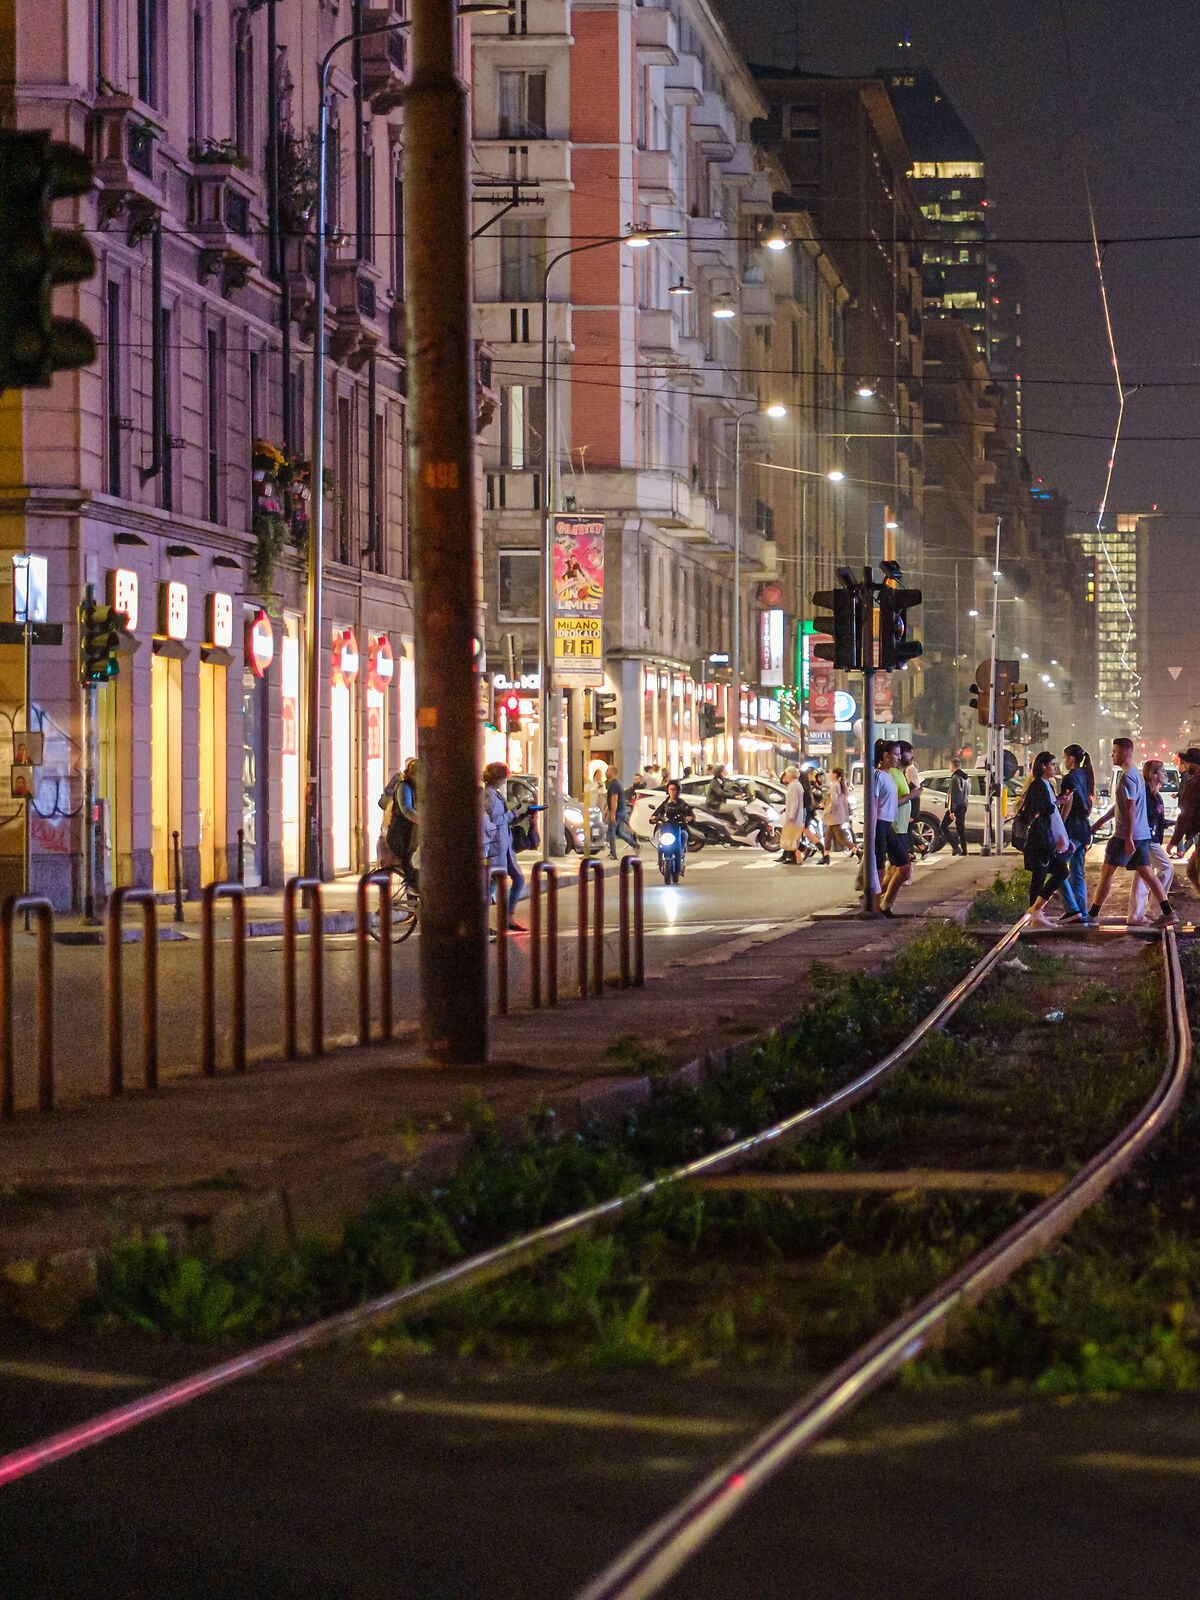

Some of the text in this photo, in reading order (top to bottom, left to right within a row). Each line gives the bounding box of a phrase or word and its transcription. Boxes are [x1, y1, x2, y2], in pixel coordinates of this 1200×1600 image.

[556, 521, 603, 535] GRAVITY
[558, 600, 599, 611] LIMITS
[557, 620, 599, 630] MILANO
[556, 629, 601, 638] IDROSCALO
[582, 643, 592, 654] 11
